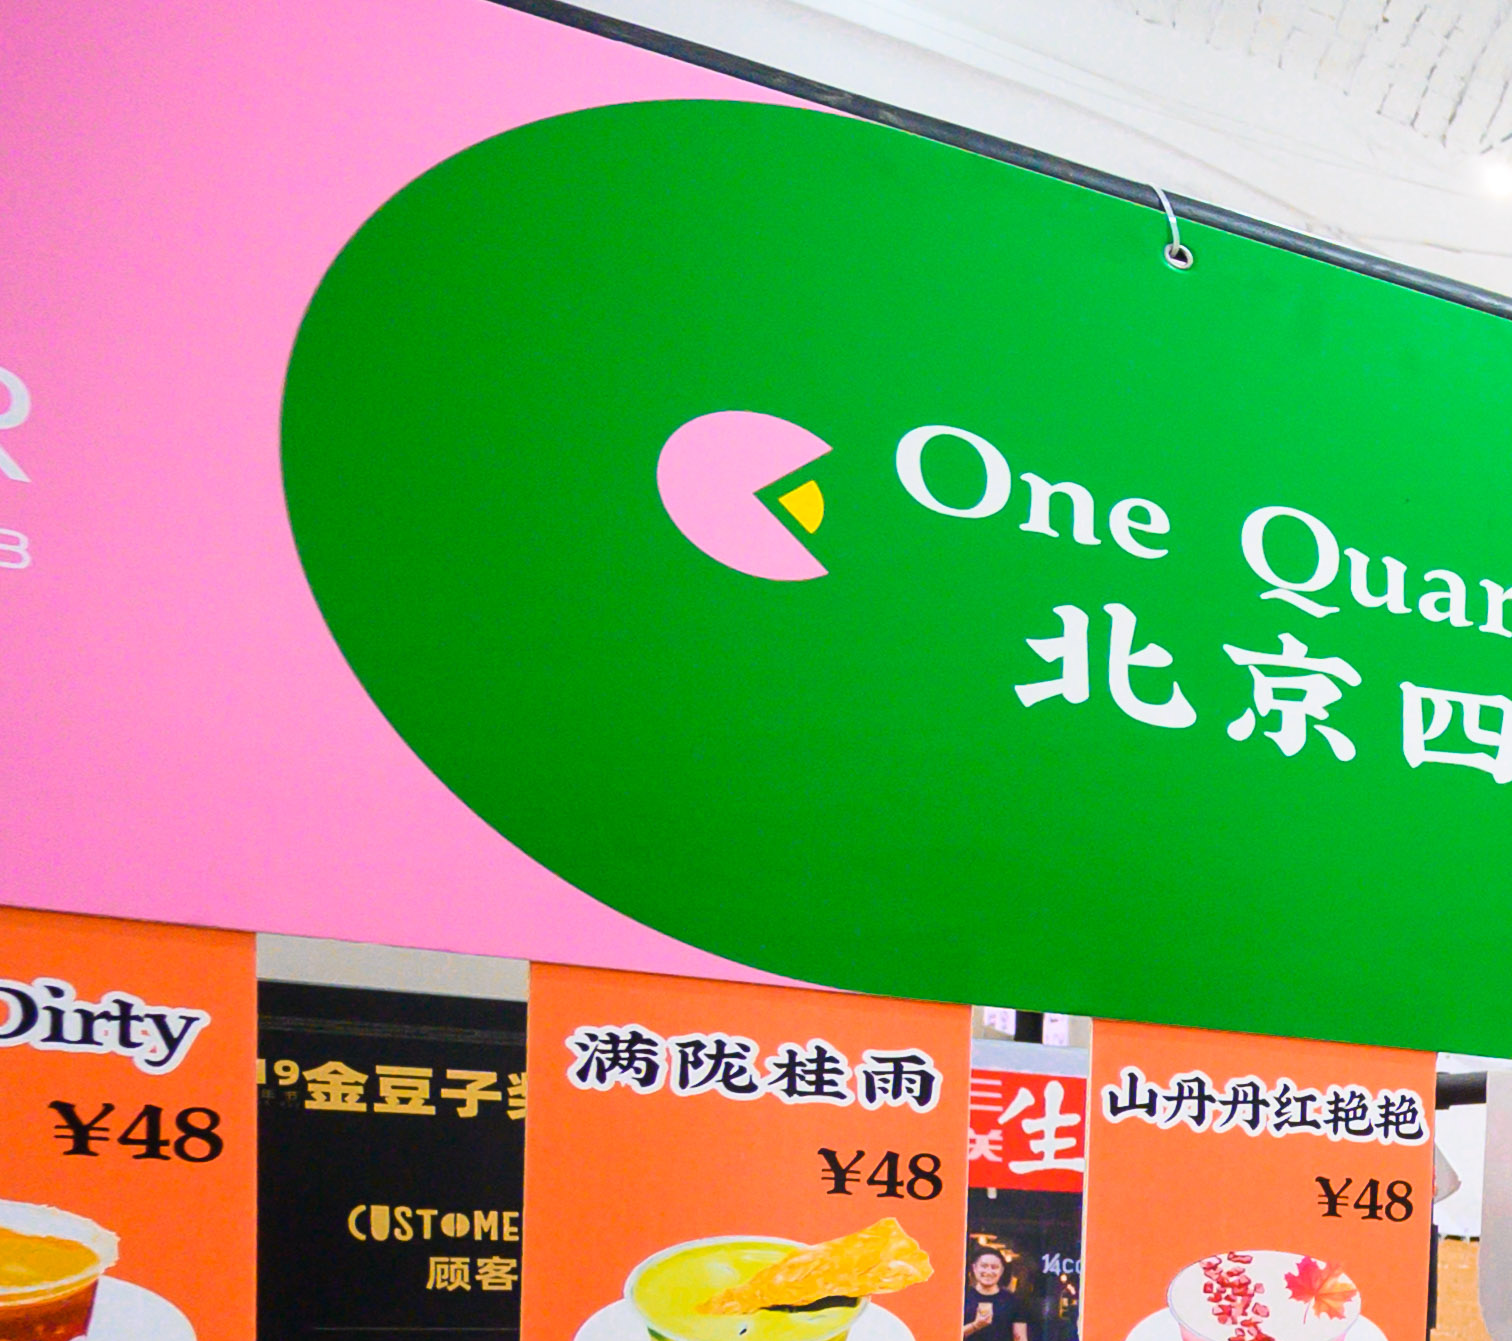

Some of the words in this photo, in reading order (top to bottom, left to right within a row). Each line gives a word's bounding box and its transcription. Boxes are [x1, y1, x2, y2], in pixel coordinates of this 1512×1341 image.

[895, 425, 1171, 559] One
[0, 983, 200, 1065] Dirty
[574, 1030, 936, 1107] 满陇桂雨
[50, 1101, 225, 1164] ¥48
[1106, 1071, 1426, 1142] 山丹丹红艳艳
[819, 1149, 944, 1200] ¥48
[1316, 1176, 1415, 1223] ¥48
[426, 1255, 519, 1292] 顾客
